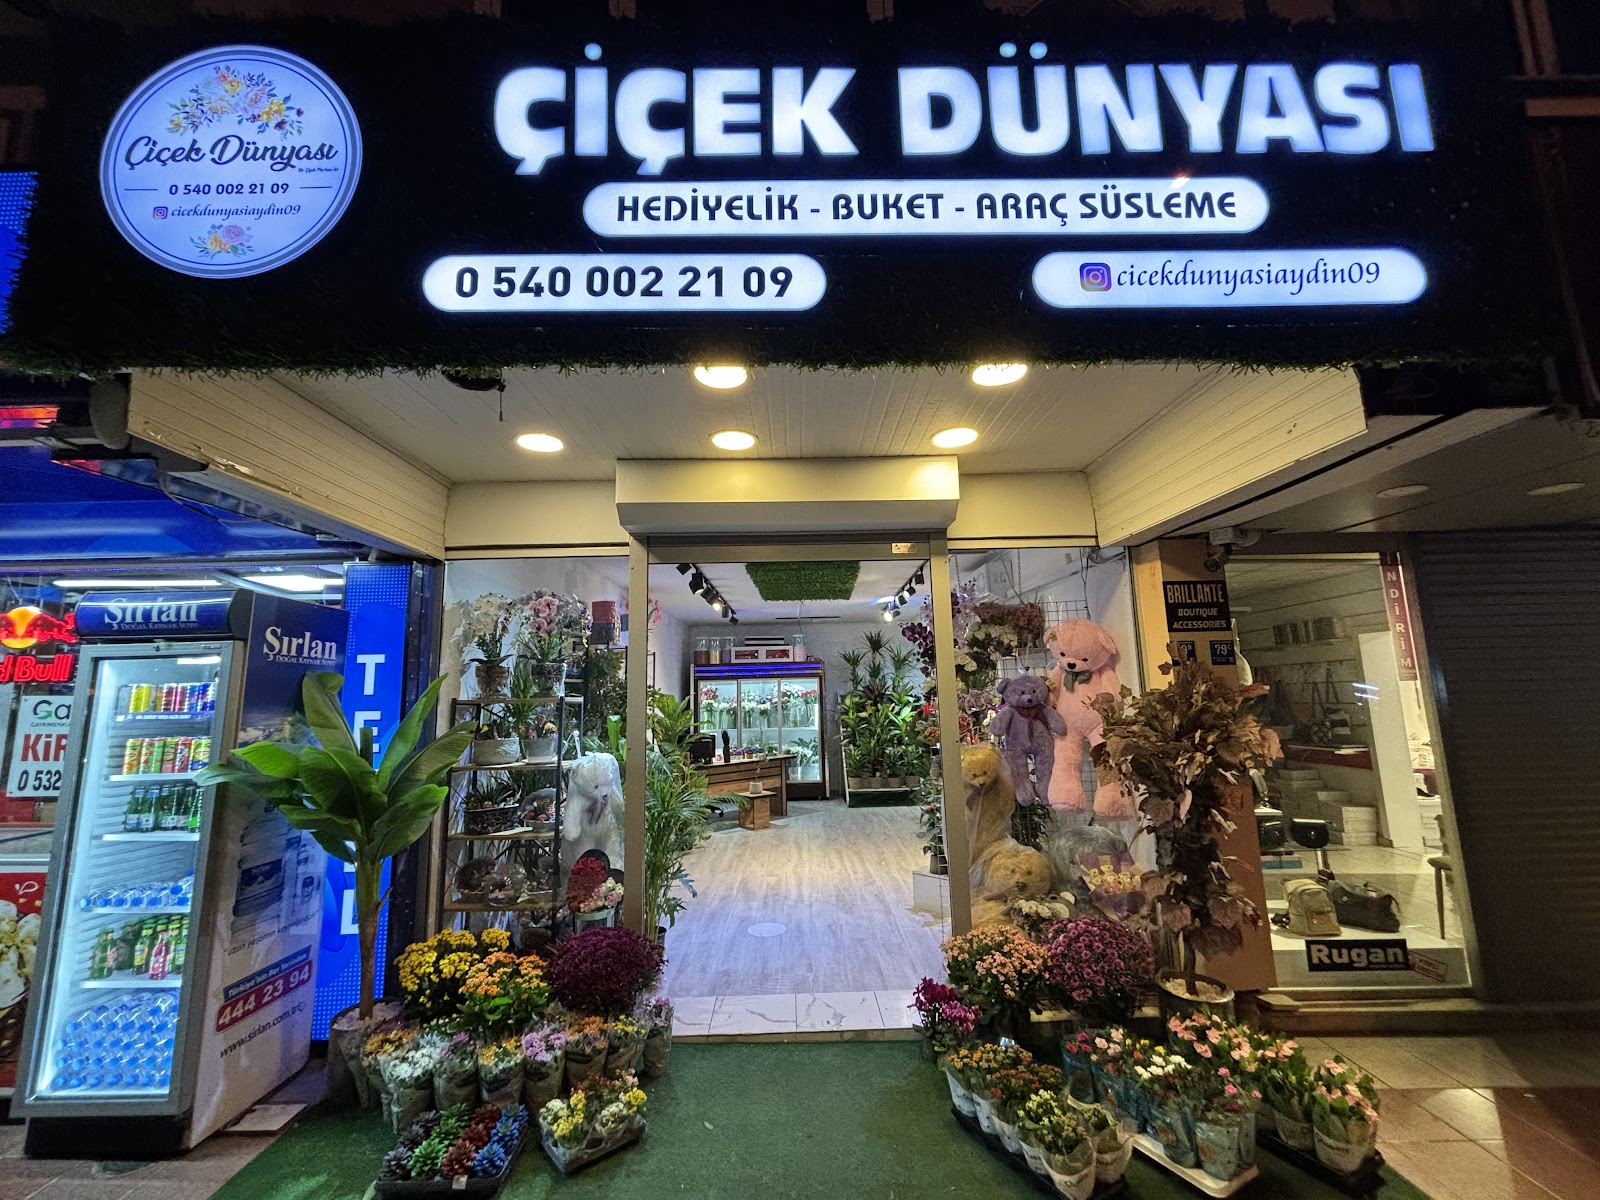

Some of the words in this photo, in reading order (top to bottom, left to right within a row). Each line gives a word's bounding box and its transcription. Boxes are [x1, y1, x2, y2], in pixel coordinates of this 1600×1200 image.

[494, 43, 859, 175] ÇİÇEK
[898, 42, 1434, 155] DÜNYASI
[125, 135, 206, 170] Çiçek
[209, 134, 339, 172] Dünyası
[169, 184, 178, 195] 0
[182, 184, 211, 195] 540
[216, 183, 244, 194] 002
[248, 183, 264, 194] 21
[270, 183, 289, 194] 09
[171, 203, 301, 221] cicekdunyasiaydin09
[617, 186, 798, 221] HEDİYELİK
[832, 193, 944, 220] BUKET
[976, 192, 1068, 227] ARAÇ
[1079, 184, 1237, 219] SÜSLEME
[455, 266, 479, 298] 0
[493, 266, 571, 298] 540
[585, 265, 663, 297] 002
[678, 265, 723, 297] 21
[743, 265, 793, 297] 09
[1117, 258, 1381, 296] cicekdunyasiaydin09
[1166, 584, 1225, 603] BRILLANTE
[1172, 620, 1227, 629] ACCESSORIES
[1178, 608, 1218, 617] BOUTIQUE
[263, 626, 337, 661] Şırlan
[14, 654, 74, 683] Bull
[17, 769, 29, 791] 0
[32, 769, 62, 791] 532
[1309, 943, 1405, 968] Rugan
[219, 994, 256, 1026] 444
[262, 979, 284, 1004] 23
[289, 965, 310, 988] 94
